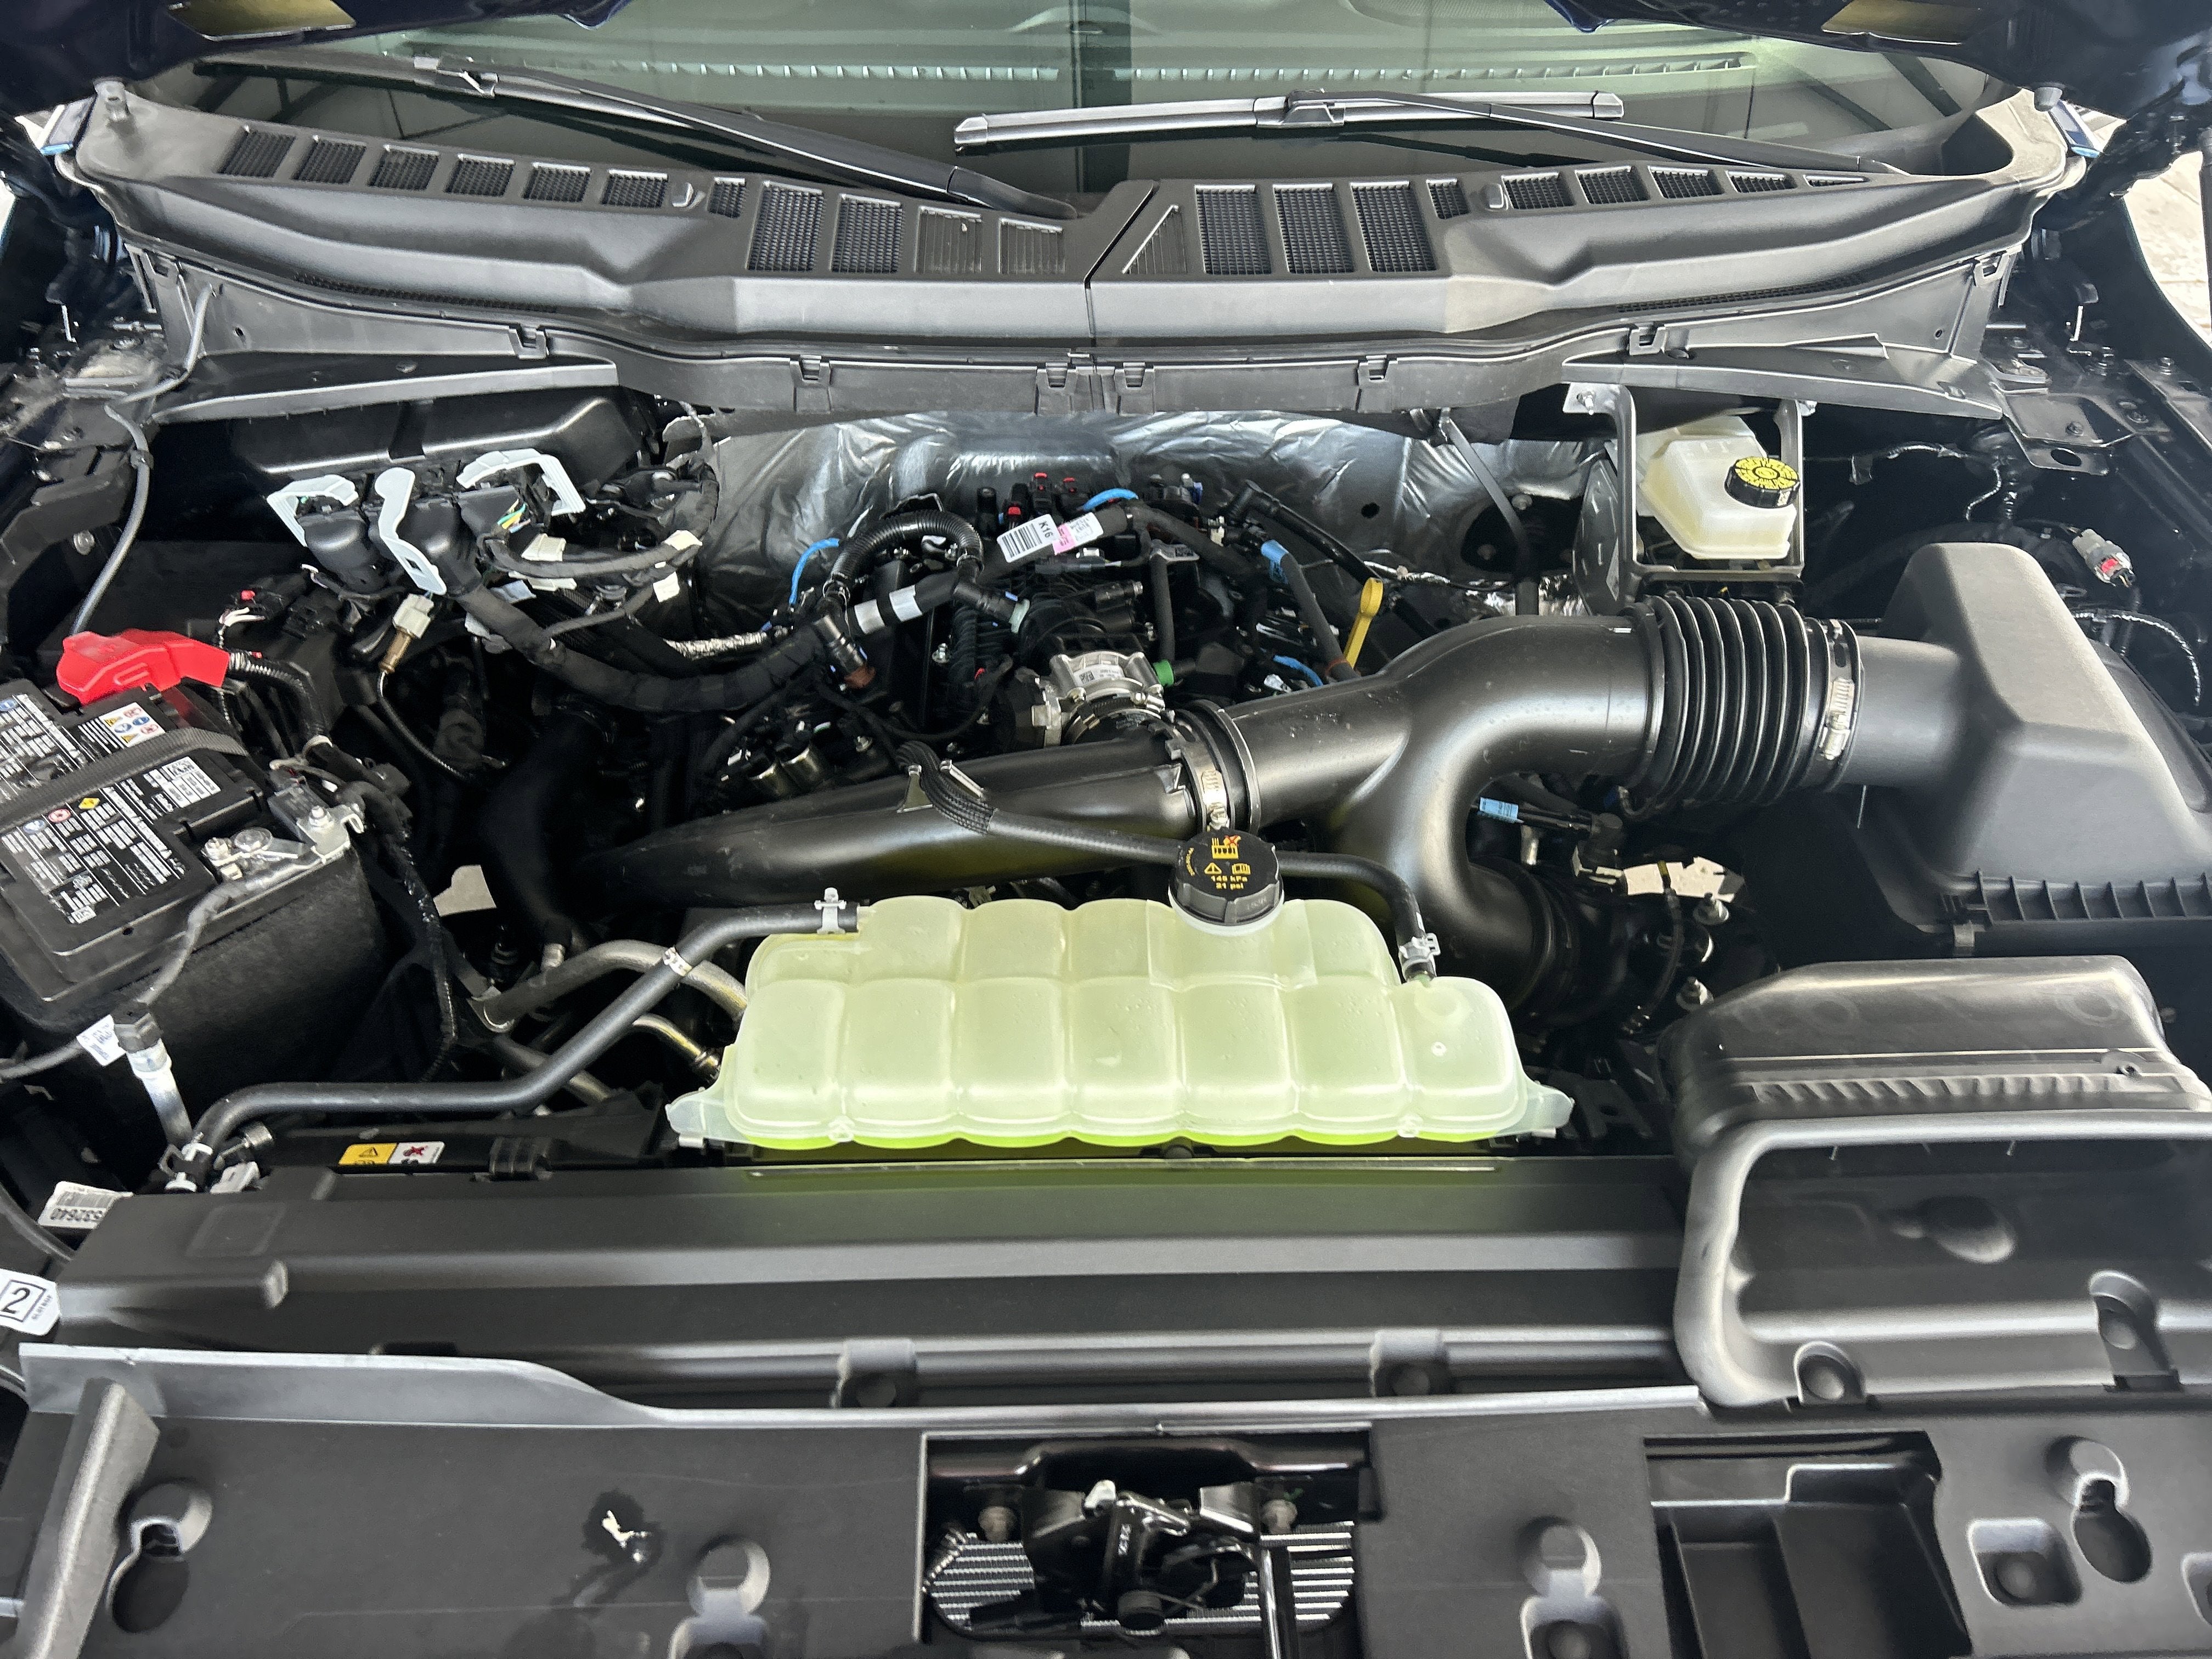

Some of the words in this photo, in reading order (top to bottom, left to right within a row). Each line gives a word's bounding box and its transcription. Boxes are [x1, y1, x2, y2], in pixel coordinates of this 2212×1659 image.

[1039, 521, 1053, 539] K16
[1230, 882, 1244, 890] psi
[1, 1287, 30, 1314] 2
